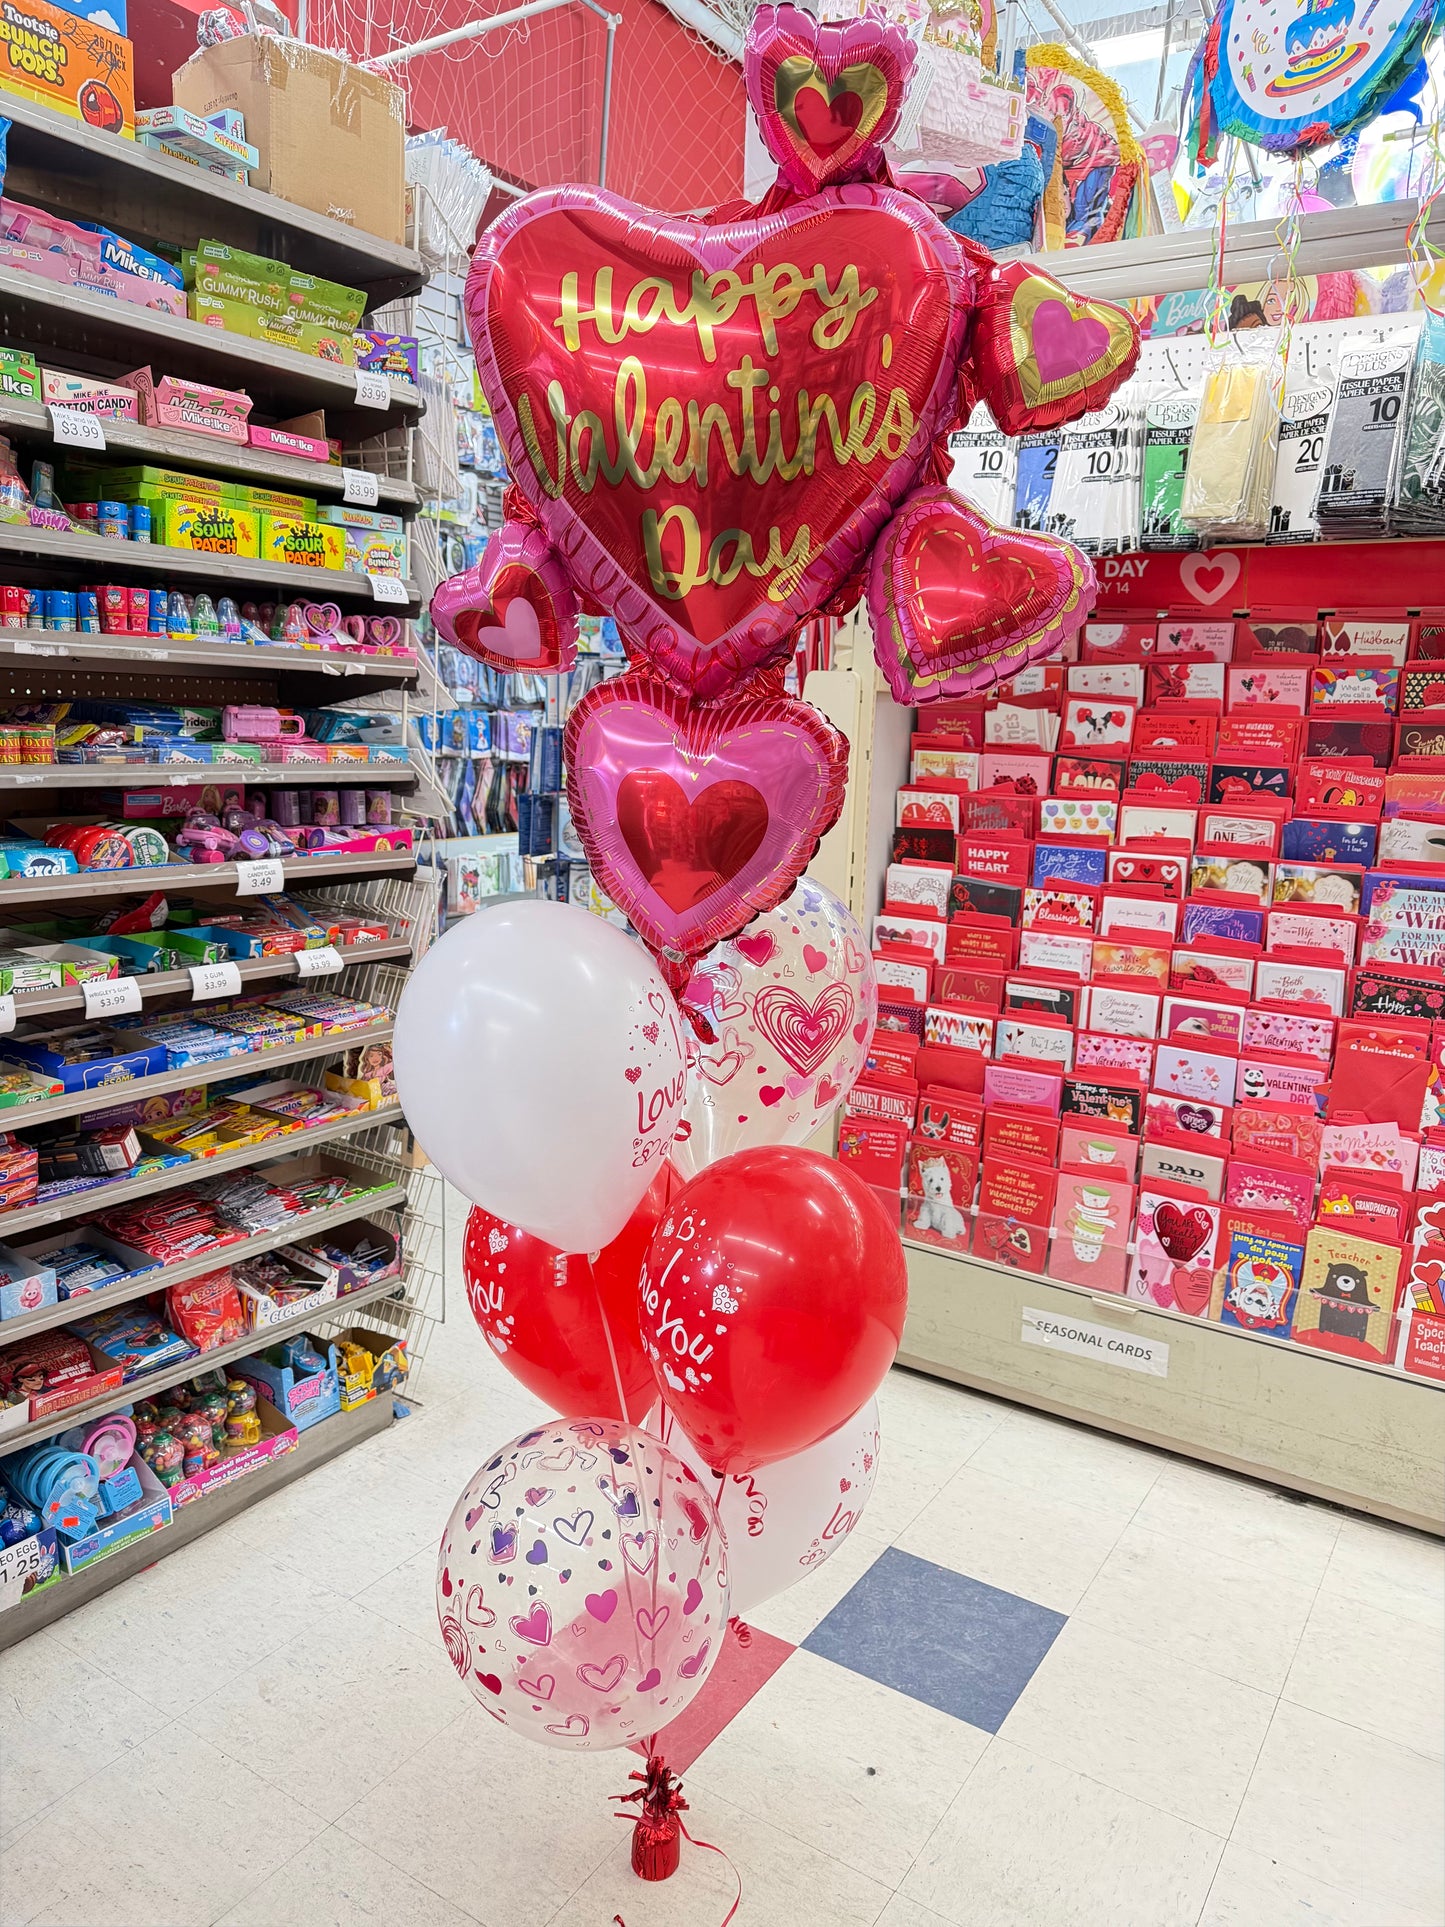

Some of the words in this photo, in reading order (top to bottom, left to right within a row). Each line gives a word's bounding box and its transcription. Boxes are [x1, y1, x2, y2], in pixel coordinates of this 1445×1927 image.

[4, 3, 58, 39] Tootsie
[0, 20, 66, 64] BUNCH
[105, 243, 151, 280] Mike
[105, 277, 126, 291] RUSH
[203, 279, 246, 300] GUMMY
[248, 292, 280, 310] RUSH
[287, 306, 325, 326] GUMMY
[328, 317, 354, 333] RUSH
[554, 262, 878, 363] Happy
[1348, 350, 1403, 367] DESIGNS
[1353, 361, 1388, 376] PLUS
[3, 373, 33, 397] Ike
[1340, 389, 1366, 398] PAPIER
[1367, 386, 1378, 395] DE
[1381, 384, 1403, 393] SOIE
[1342, 381, 1370, 391] TISSUE
[1371, 375, 1400, 387] PAPER
[73, 391, 92, 400] MIKE
[96, 389, 110, 397] IKE
[361, 387, 387, 401] $3.99
[1288, 389, 1328, 408] DESIGNS
[50, 399, 95, 412] COTTON
[97, 397, 132, 410] CANDY
[1292, 403, 1315, 418] PLUS
[1369, 396, 1400, 422] 10
[182, 411, 212, 426] Mike
[214, 418, 231, 432] Ike
[518, 333, 919, 498] Valentine's
[1076, 417, 1101, 429] PLUS
[1161, 413, 1190, 426] PLUS
[61, 421, 99, 438] $3.99
[1280, 430, 1301, 440] PAPIER
[1302, 428, 1308, 436] DE
[1309, 425, 1326, 435] SOIE
[1281, 421, 1304, 432] TISSUE
[1305, 417, 1326, 428] PAPER
[271, 431, 297, 447] Mike
[299, 439, 313, 451] Ike
[955, 433, 980, 441] TISSUE
[981, 432, 1003, 440] PAPER
[1022, 431, 1046, 440] TISSUE
[1067, 432, 1090, 442] TISSUE
[1090, 431, 1112, 440] PAPER
[1148, 437, 1176, 445] PAPIER
[1150, 430, 1177, 438] TISSUE
[952, 440, 977, 448] PAPIER
[1062, 440, 1087, 450] PAPIER
[1088, 440, 1096, 448] DE
[1096, 439, 1114, 447] SOIE
[1296, 436, 1324, 464] 20
[979, 449, 1003, 471] 10
[1087, 450, 1111, 474] 10
[164, 474, 185, 485] SOUR
[184, 479, 206, 491] PATCH
[349, 484, 375, 498] $3.99
[30, 508, 70, 529] PAINT
[193, 522, 234, 540] SOUR
[192, 538, 237, 554] PATCH
[286, 536, 323, 553] SOUR
[641, 504, 825, 601] Day
[285, 551, 326, 567] PATCH
[1105, 560, 1150, 578] DAY
[377, 583, 403, 595] $3.99
[1116, 582, 1130, 595] 14
[1354, 629, 1405, 646] Husband
[183, 717, 216, 727] Trident
[162, 796, 191, 815] Barbie
[967, 802, 1003, 818] Happy
[1213, 831, 1237, 842] ONE
[968, 848, 1009, 860] HAPPY
[24, 858, 66, 878] excel
[968, 861, 1009, 873] HEART
[251, 877, 271, 887] 3.49
[1407, 894, 1428, 903] FOR
[1039, 908, 1079, 924] Blessings
[1220, 924, 1256, 940] Wife
[1296, 926, 1314, 937] Wife
[1401, 931, 1422, 940] FOR
[1426, 934, 1443, 942] MY
[311, 959, 331, 970] $3.99
[13, 983, 54, 993] SPEARMINT
[205, 979, 227, 990] $3.99
[1281, 975, 1304, 987] Both
[88, 988, 117, 999] WRIGLEY'S
[118, 985, 129, 994] GUM
[100, 995, 125, 1007] $3.99
[1101, 995, 1123, 1010] You're
[1371, 995, 1412, 1012] Happy
[1210, 1022, 1239, 1035] SPECIAL!
[97, 1073, 136, 1087] SESAME
[1266, 1078, 1312, 1094] VALENTINE
[849, 1090, 879, 1110] HONEY
[881, 1096, 905, 1114] BUNS
[1071, 1090, 1133, 1107] Valentine's
[1289, 1093, 1312, 1105] DAY
[951, 1123, 977, 1134] HONEY,
[1257, 1137, 1290, 1149] Mother
[1344, 1136, 1397, 1149] Mother
[1158, 1161, 1204, 1179] DAD
[1244, 1175, 1293, 1193] Grandma
[1355, 1200, 1399, 1218] GRANDPARENTS
[1227, 1219, 1254, 1236] CATS
[1234, 1233, 1254, 1245] fun!
[1268, 1240, 1289, 1252] ready
[1249, 1244, 1263, 1254] up
[1264, 1248, 1288, 1261] fired
[1237, 1251, 1273, 1267] you're
[1274, 1259, 1293, 1271] Hope
[1327, 1248, 1371, 1267] Teacher
[270, 1303, 302, 1324] BLOW
[304, 1291, 328, 1310] POP
[1035, 1320, 1104, 1348] SEASONAL
[1107, 1339, 1153, 1361] CARDS
[288, 1380, 320, 1398] SOUR
[210, 1458, 235, 1476] Gumball
[235, 1448, 260, 1465] Machine
[16, 1540, 38, 1559] EGG
[0, 1552, 40, 1584] 1.25
